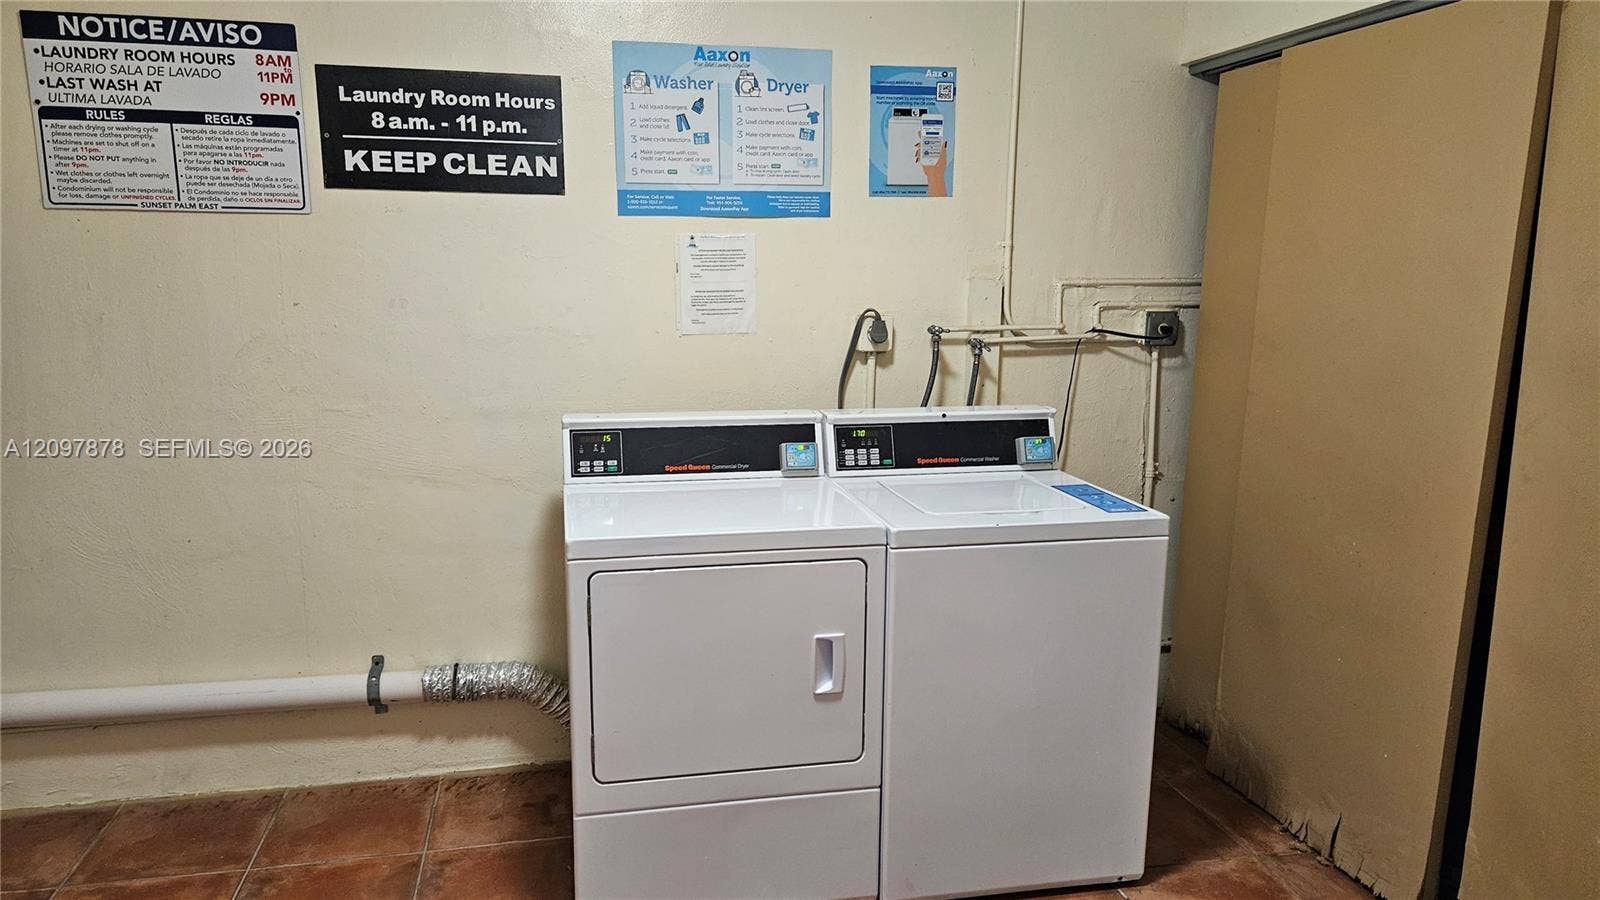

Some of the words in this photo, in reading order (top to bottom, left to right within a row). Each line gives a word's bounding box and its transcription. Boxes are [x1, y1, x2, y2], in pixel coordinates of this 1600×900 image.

[57, 14, 262, 46] NOTICE/AVISO
[40, 45, 118, 60] LAUNDRY
[124, 49, 175, 63] ROOM
[180, 51, 236, 66] HOURS
[255, 53, 292, 67] 8AM
[693, 45, 751, 62] Aaxon
[44, 61, 106, 74] HORARIO
[110, 64, 143, 75] SALA
[147, 66, 165, 77] DE
[169, 67, 221, 79] LAVADO
[257, 72, 293, 84] 11PM
[925, 69, 953, 78] Aaxon
[46, 76, 85, 89] LAST
[89, 78, 138, 91] WASH
[143, 80, 162, 92] AT
[653, 74, 714, 90] Washer
[766, 78, 809, 96] Dryer
[48, 92, 96, 104] ULTIMA
[100, 94, 152, 106] LAVADA
[260, 92, 296, 107] 9PM
[338, 85, 426, 108] Laundry
[430, 89, 490, 108] Room
[495, 92, 556, 110] Hours
[86, 109, 126, 120] RULES
[204, 114, 253, 126] REGLAS
[736, 118, 743, 126] 2
[371, 111, 385, 128] 8
[388, 117, 435, 130] a.m.
[456, 114, 477, 132] 11
[482, 119, 528, 136] p.m.
[344, 149, 437, 174] KEEP
[443, 152, 558, 178] CLEAN
[664, 464, 688, 472] Speed
